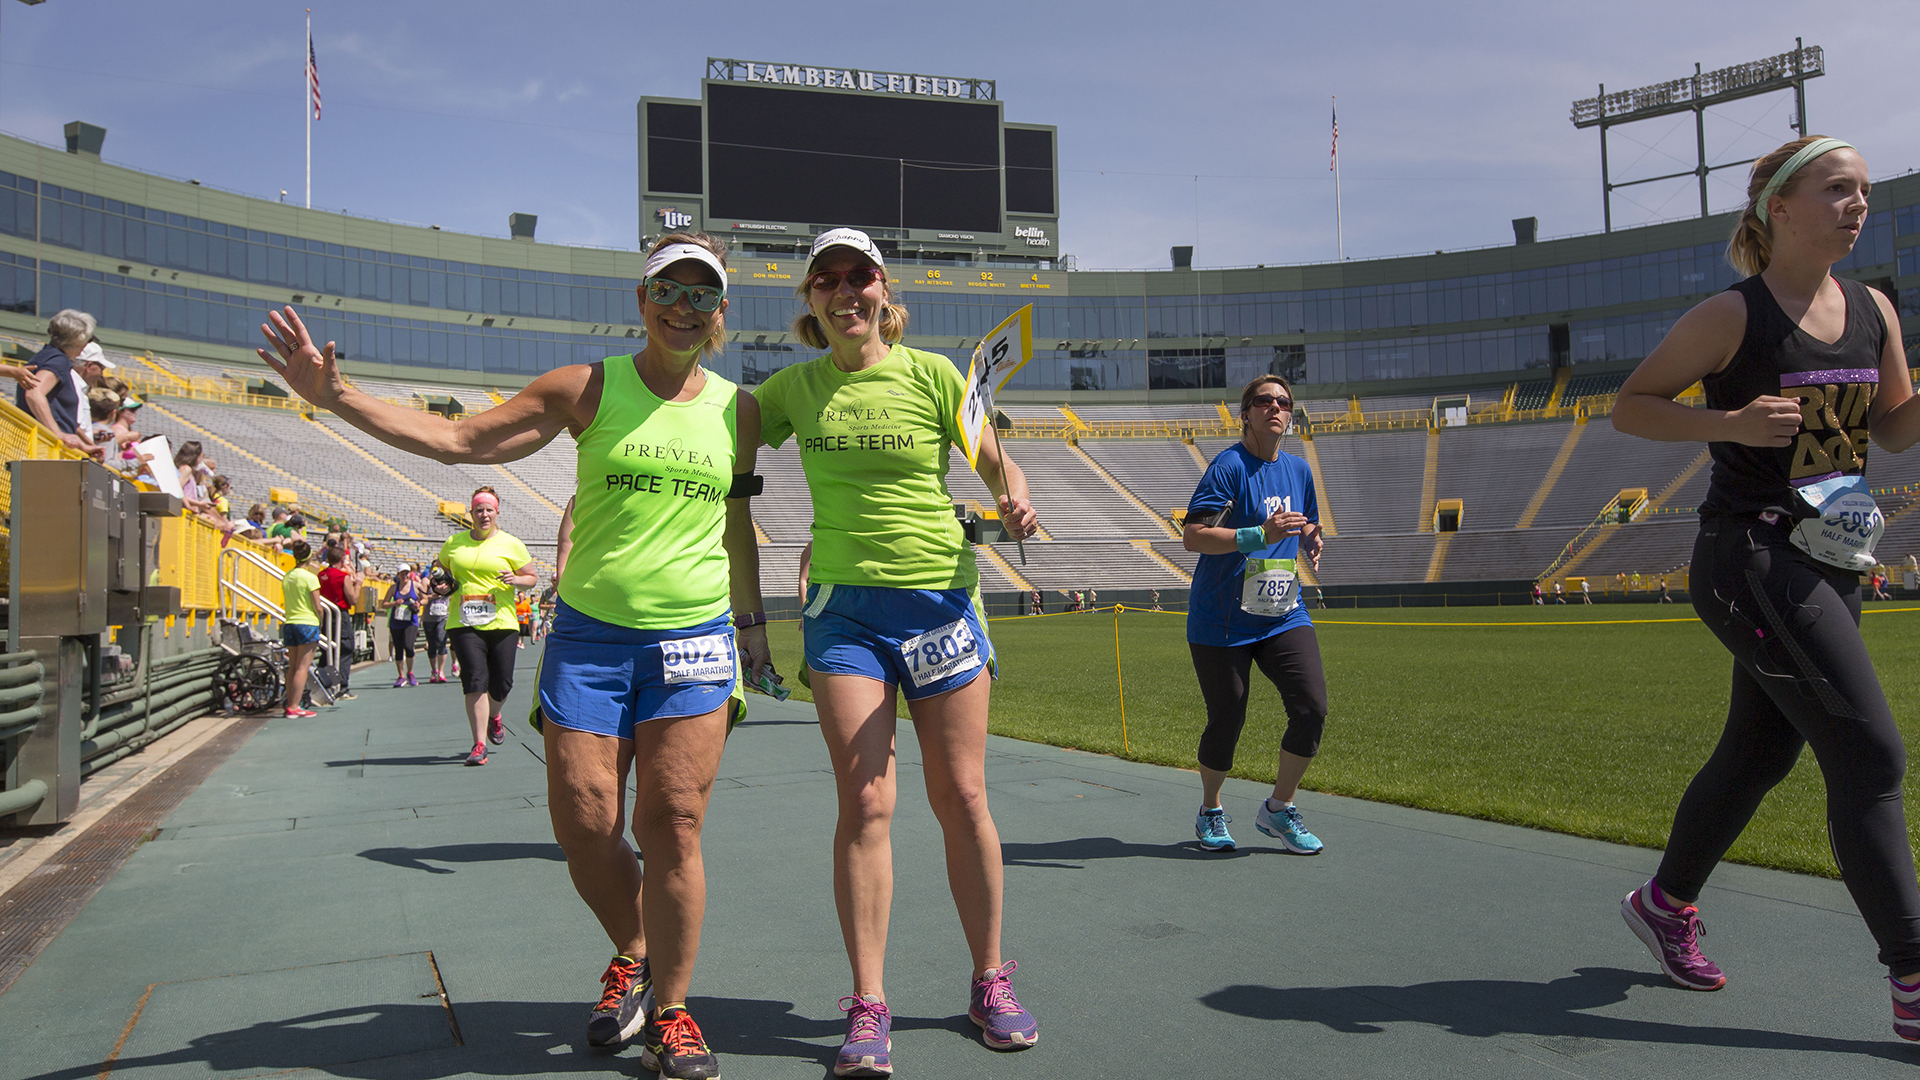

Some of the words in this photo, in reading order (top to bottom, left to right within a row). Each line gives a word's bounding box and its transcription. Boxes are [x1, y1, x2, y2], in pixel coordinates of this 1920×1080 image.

[746, 62, 874, 91] LAMBEAU
[887, 74, 961, 97] FIELD
[664, 211, 692, 229] Lite
[1015, 226, 1044, 238] bellin
[1026, 237, 1050, 246] health
[766, 263, 778, 272] 14
[927, 270, 941, 279] 66
[980, 272, 993, 281] 92
[1031, 273, 1038, 282] 4
[815, 408, 890, 423] PREVEA
[805, 435, 849, 453] PACE
[855, 434, 914, 450] TEAM
[623, 443, 714, 468] PREVEA
[664, 465, 689, 475] Sports
[690, 469, 721, 482] Medicine
[606, 474, 664, 494] PACE
[670, 478, 722, 506] TEAM
[1820, 529, 1843, 542] HALF
[1257, 580, 1293, 597] 7857
[908, 632, 931, 646] CELLCOM
[931, 624, 948, 636] GREEN
[948, 622, 958, 630] BAY
[662, 635, 733, 667] 8021
[903, 628, 976, 673] 7803
[670, 669, 691, 678] HALF
[692, 665, 733, 676] MARATHON
[918, 668, 936, 681] HALF
[937, 654, 975, 674] MARATHON
